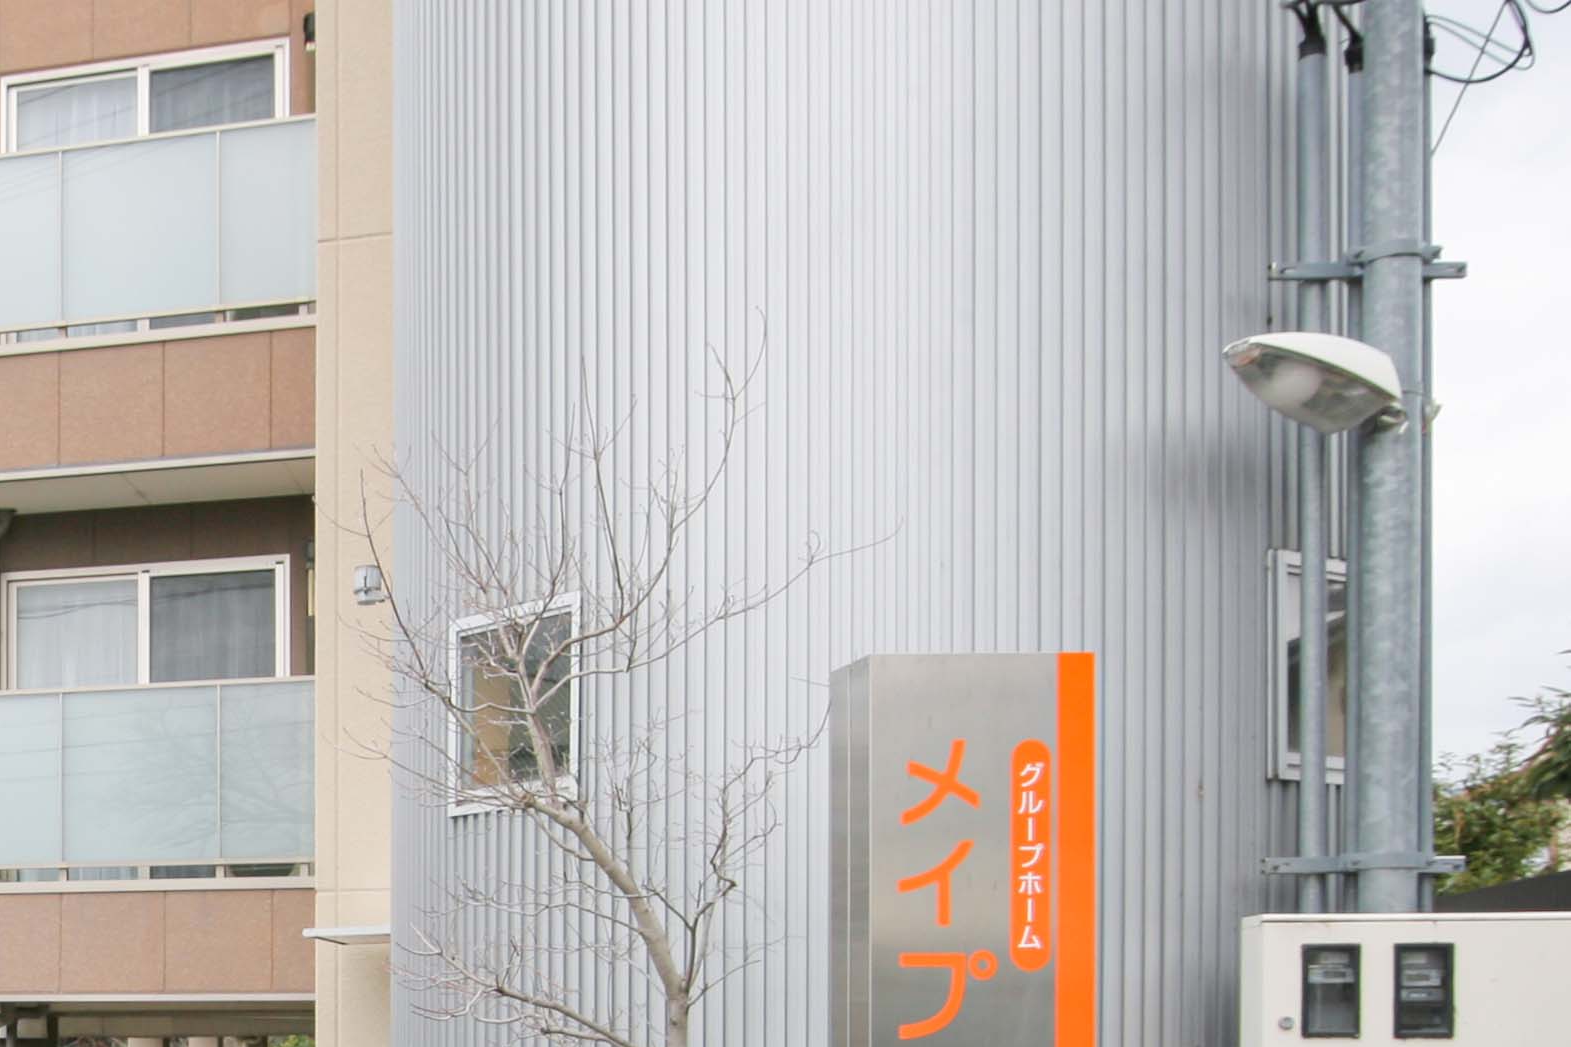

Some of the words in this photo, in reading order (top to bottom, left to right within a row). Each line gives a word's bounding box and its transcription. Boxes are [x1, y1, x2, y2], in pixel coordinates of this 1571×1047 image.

[1017, 762, 1044, 949] グループホーム
